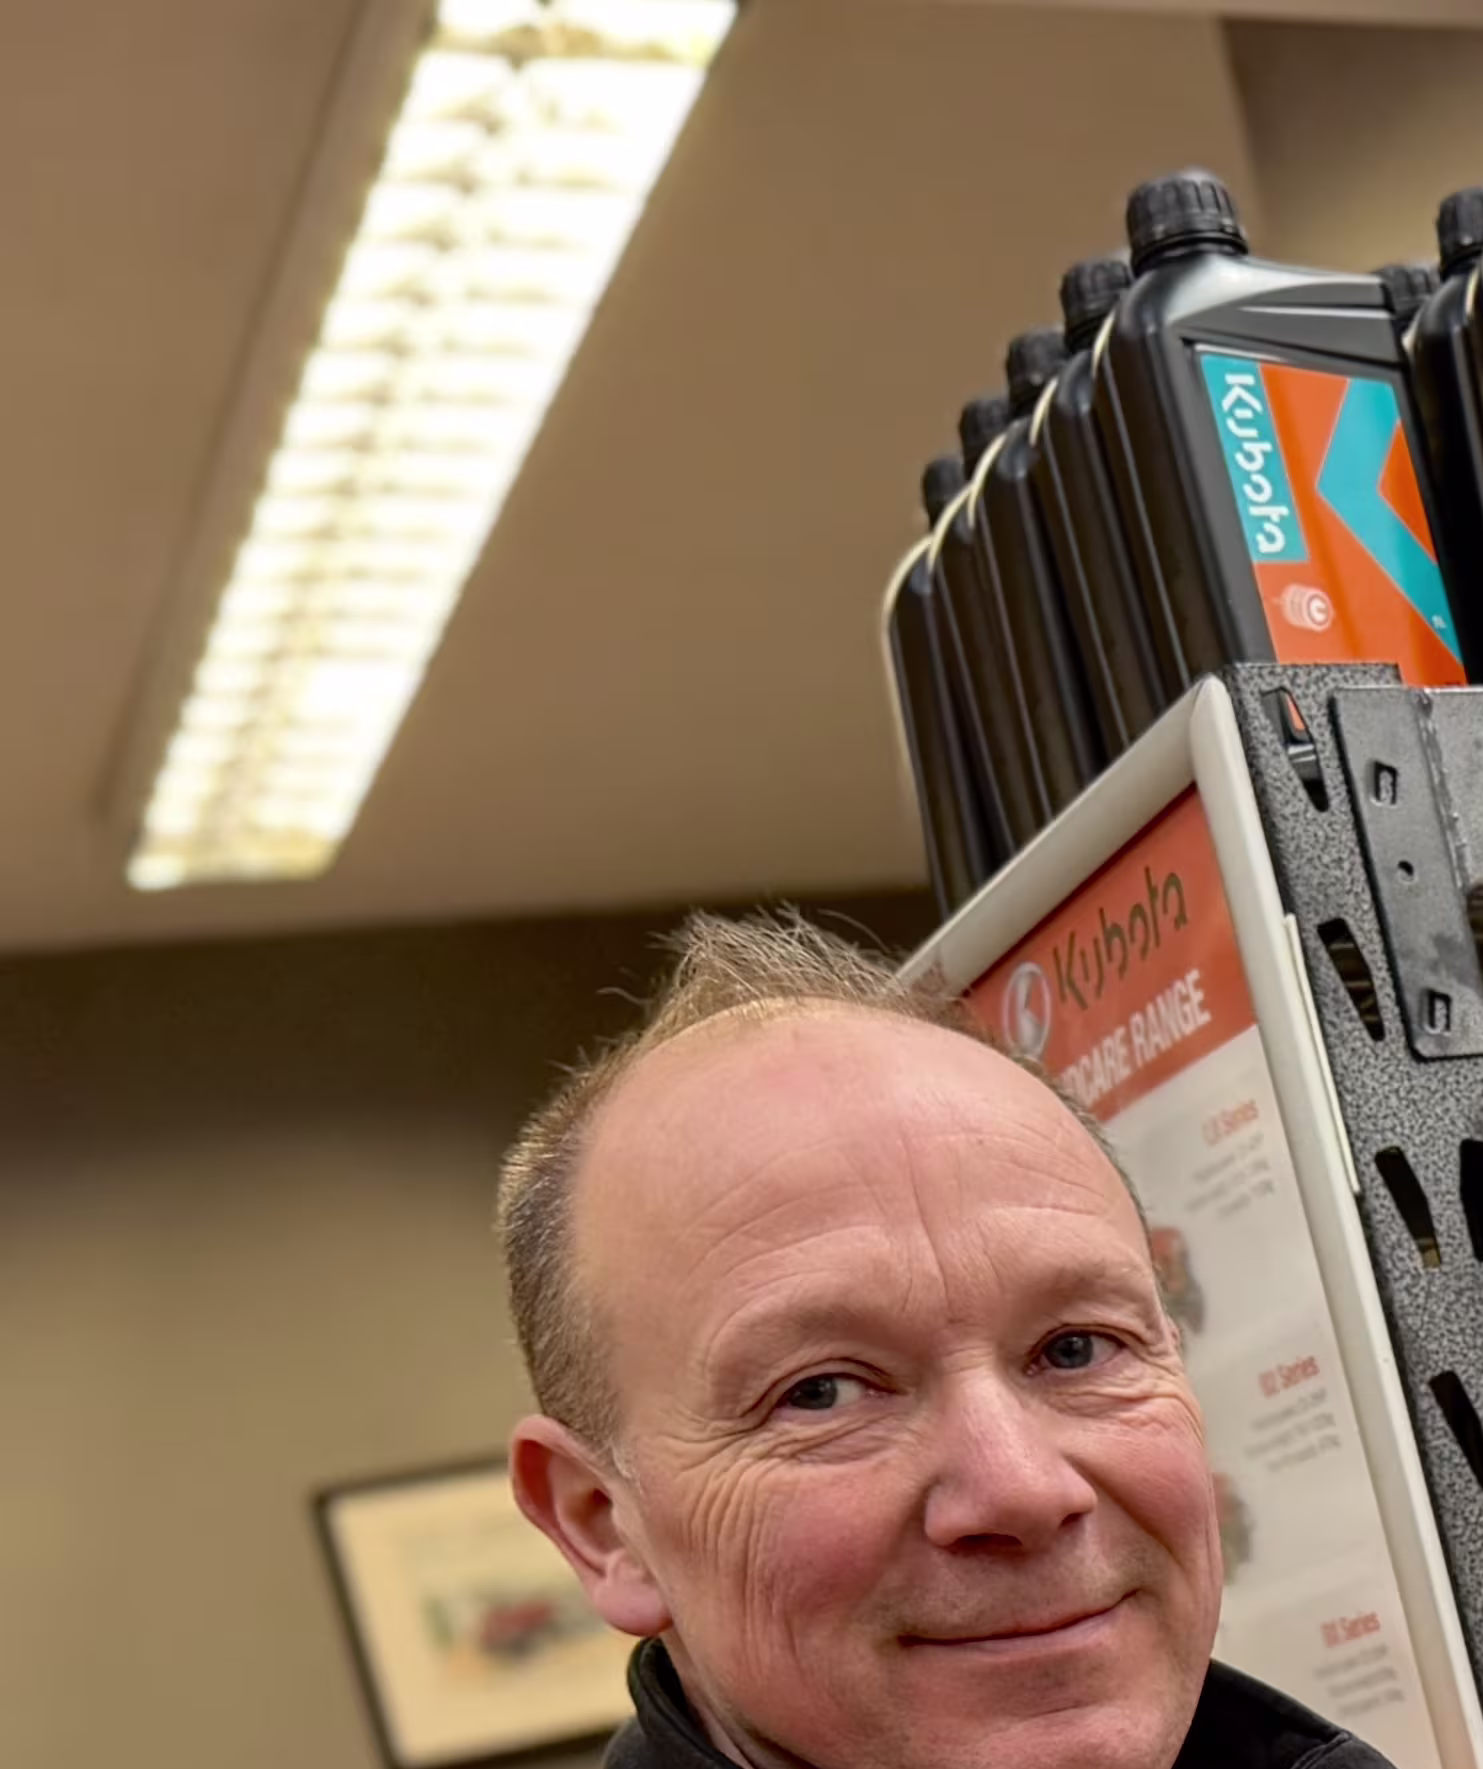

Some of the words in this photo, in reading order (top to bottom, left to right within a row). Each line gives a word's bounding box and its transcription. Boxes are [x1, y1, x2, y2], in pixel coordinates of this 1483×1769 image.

[1221, 373, 1288, 556] Kubota
[1051, 865, 1188, 1011] Kubota
[1128, 967, 1213, 1070] RANGE
